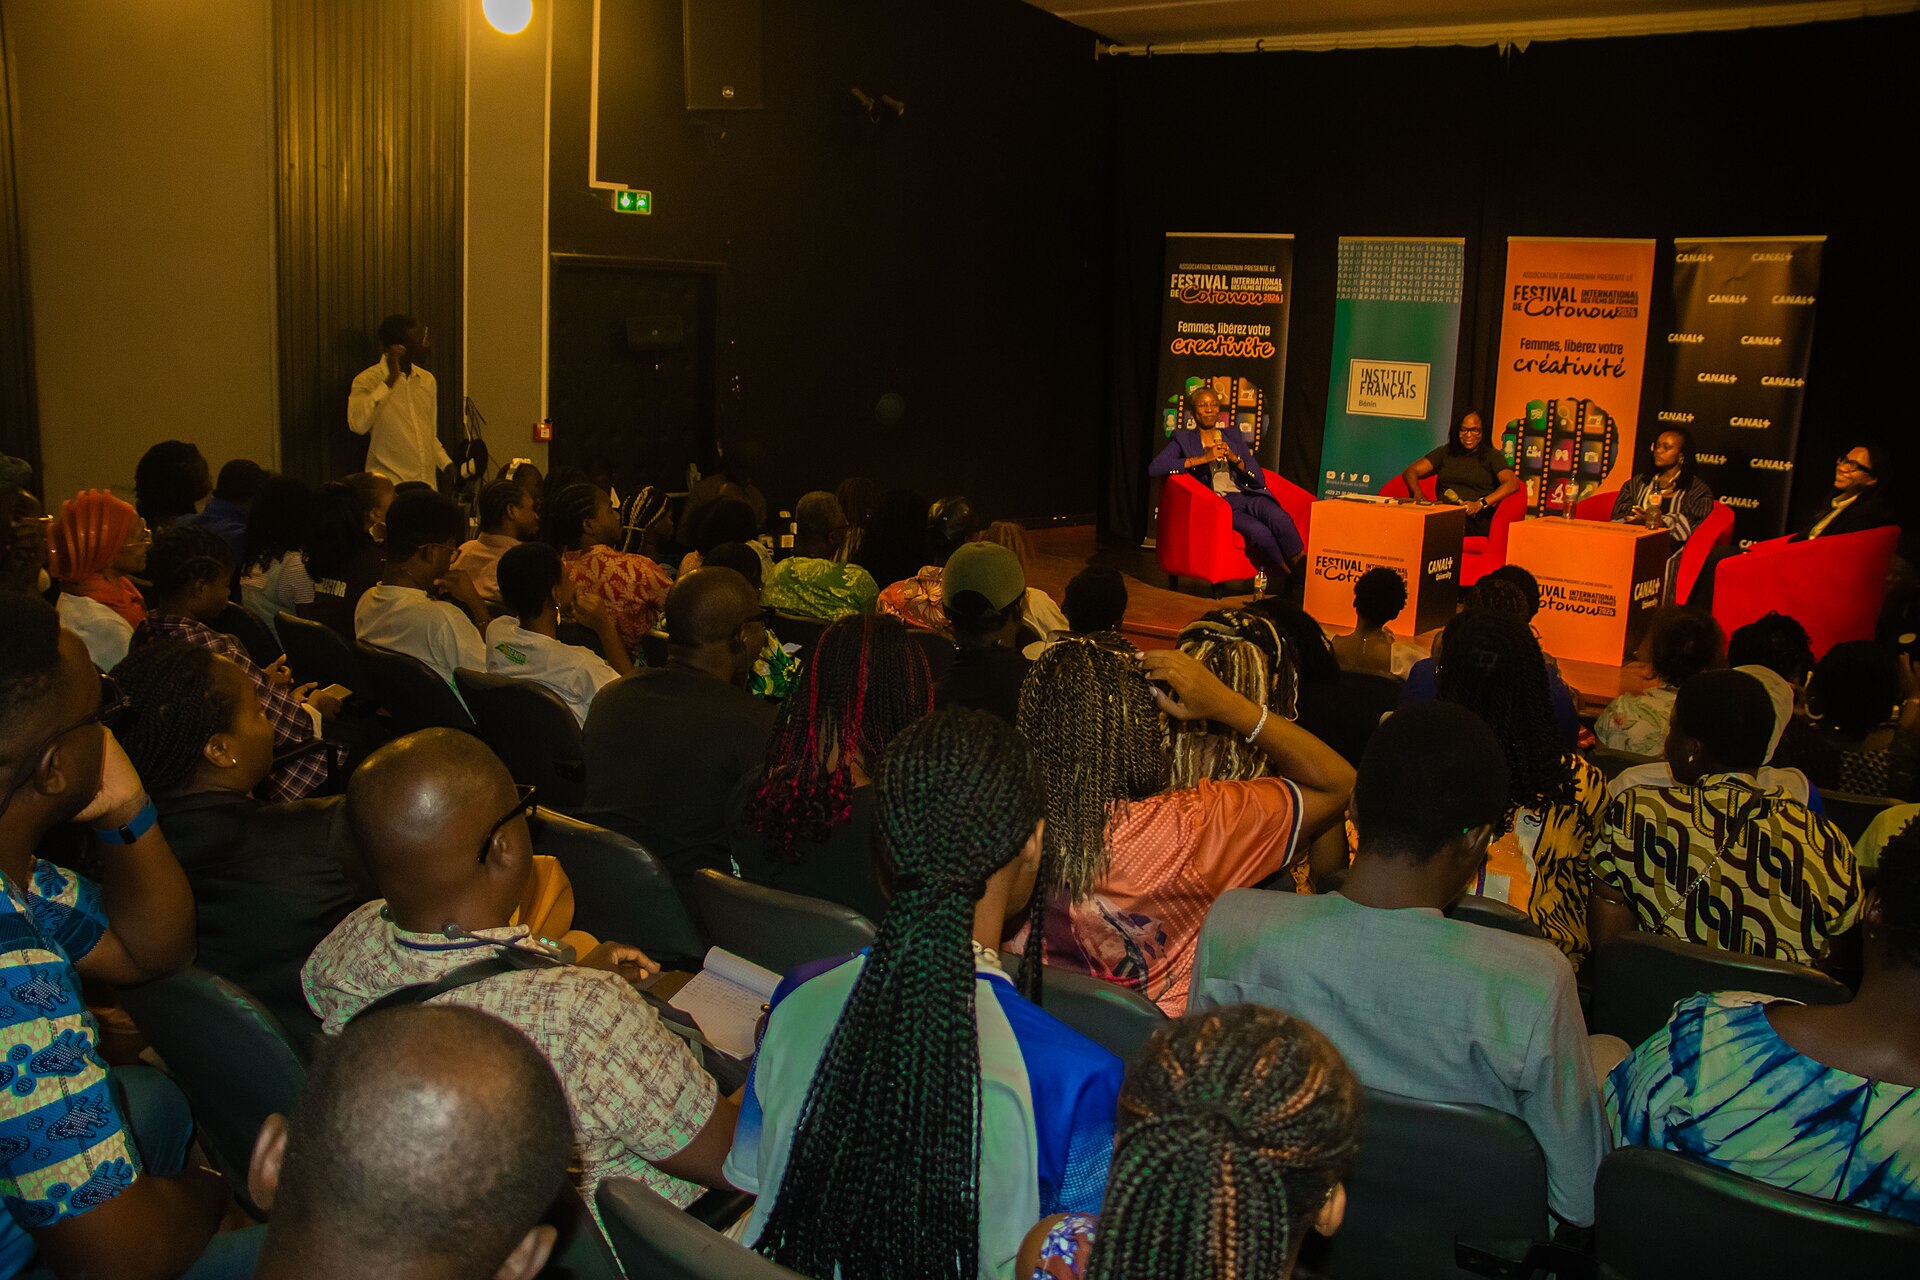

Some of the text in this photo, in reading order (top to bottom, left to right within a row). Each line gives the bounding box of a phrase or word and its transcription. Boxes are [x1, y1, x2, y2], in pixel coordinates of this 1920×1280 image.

[1676, 253, 1714, 263] CANAL+
[1751, 253, 1793, 262] CANAL+
[1171, 273, 1282, 290] FESTIVAL INTERNATIONAL
[1170, 289, 1179, 298] DE
[1514, 285, 1638, 303] FESTIVAL INTERNATIONAL
[1708, 294, 1748, 303] CANAL+
[1772, 295, 1816, 305] CANAL+
[1512, 302, 1522, 311] DE
[1177, 320, 1216, 335] Femmes,
[1247, 324, 1271, 336] votre
[1667, 333, 1704, 343] CANAL+
[1740, 335, 1782, 345] CANAL+
[1520, 338, 1562, 352] Femmes,
[1598, 342, 1624, 354] votre
[1513, 353, 1626, 378] créativité
[1361, 368, 1412, 385] INSTITUT
[1697, 372, 1738, 383] CANAL+
[1760, 376, 1805, 387] CANAL+
[1360, 381, 1417, 400] FRANÇAIS
[1658, 411, 1695, 422] CANAL+
[1729, 417, 1771, 429] CANAL+
[1749, 458, 1794, 471] CANAL+
[1718, 495, 1760, 508] CANAL+
[1315, 555, 1362, 572] FESTIVAL
[1427, 556, 1453, 574] CANAL+
[1634, 577, 1660, 601] CANAL+
[1569, 590, 1616, 601] INTERNATIONAL
